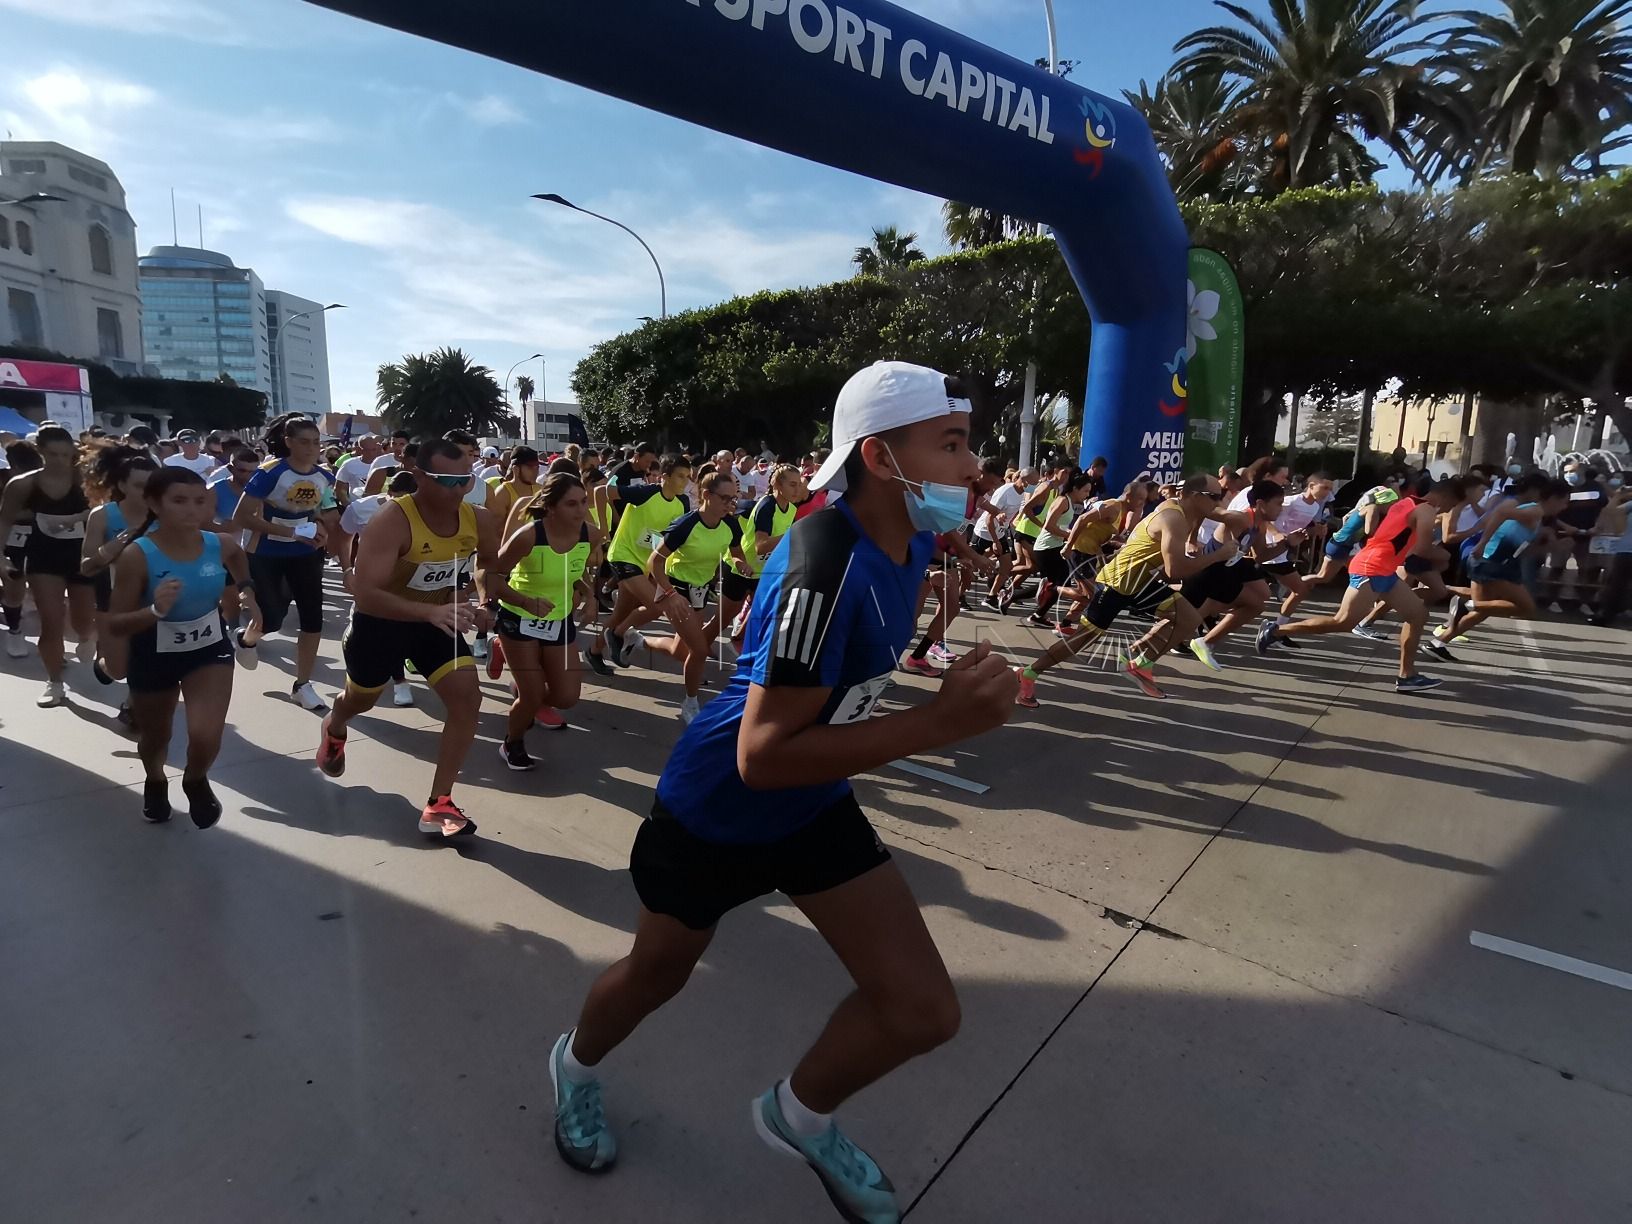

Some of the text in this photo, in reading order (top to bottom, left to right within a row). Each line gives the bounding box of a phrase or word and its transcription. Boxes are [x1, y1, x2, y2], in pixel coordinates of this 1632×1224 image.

[900, 39, 1055, 145] CAPITAL
[173, 624, 212, 644] 314
[528, 618, 553, 632] 331
